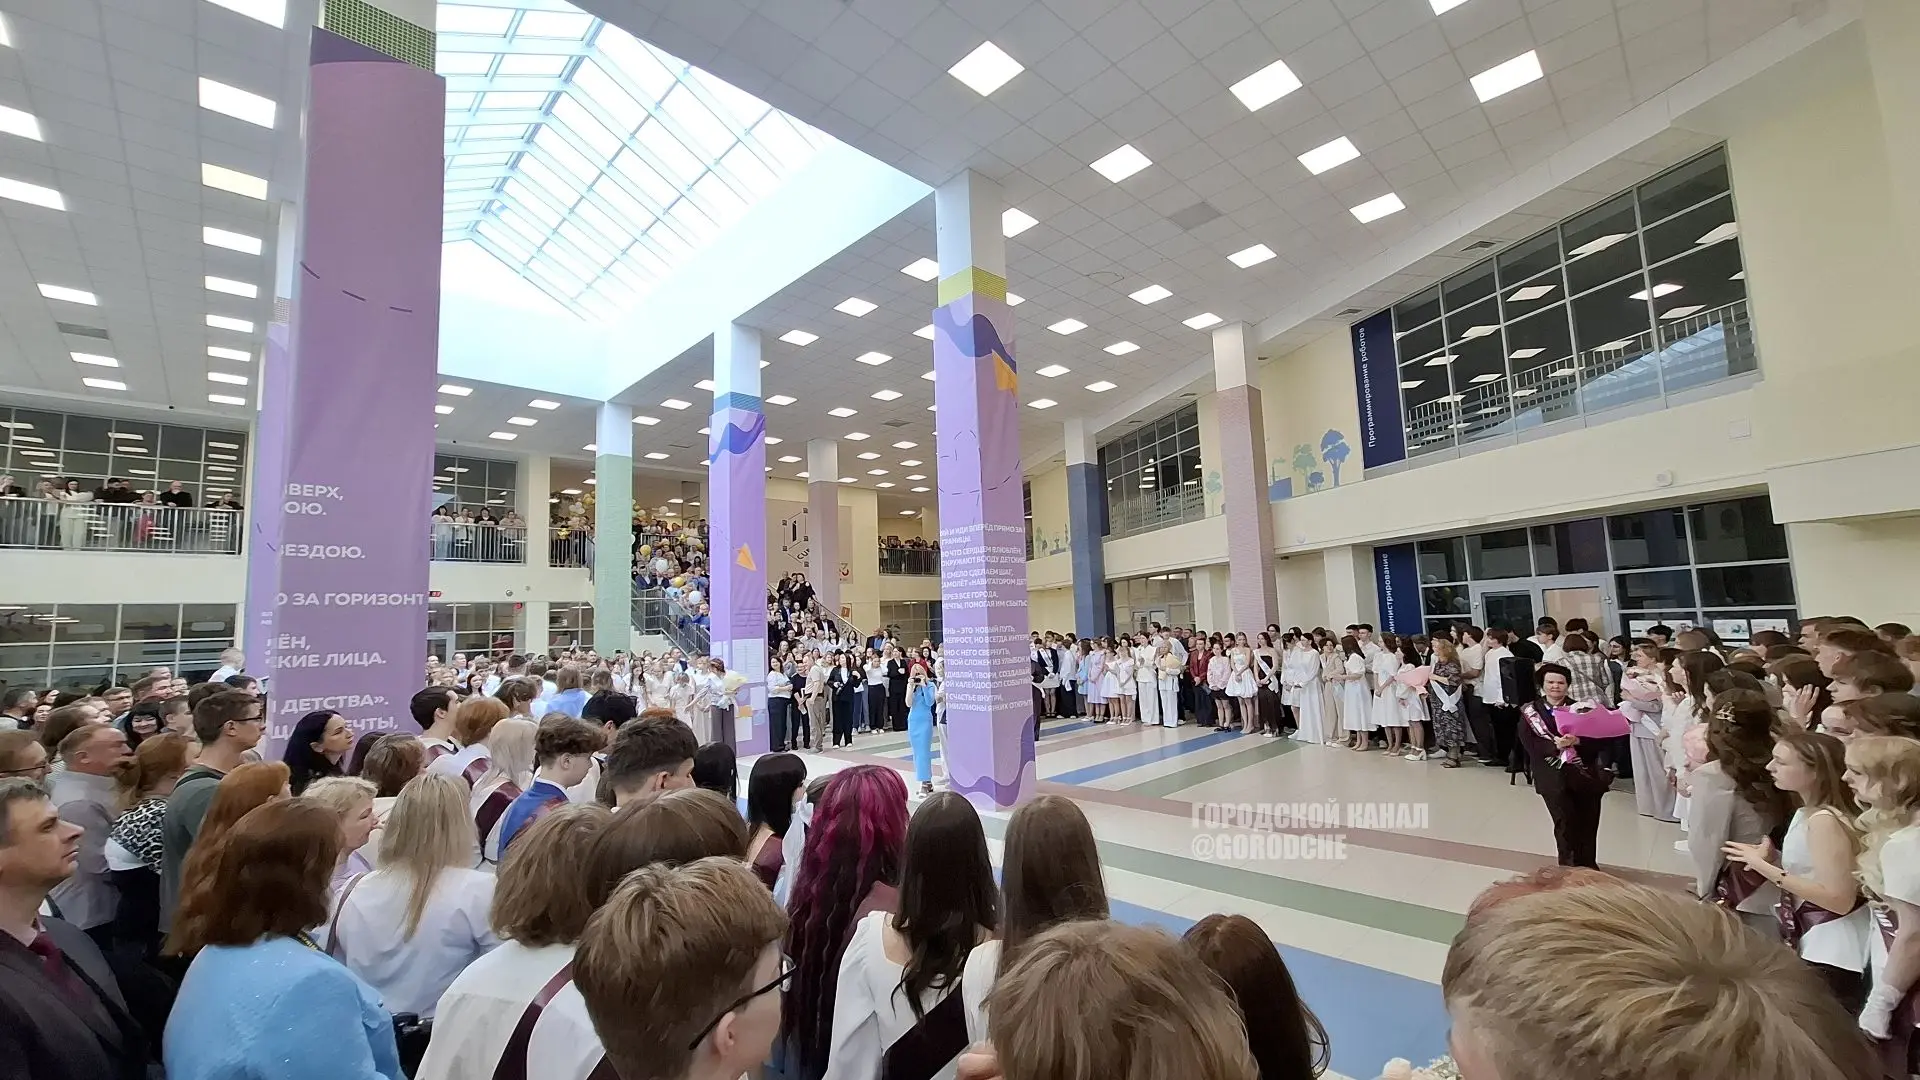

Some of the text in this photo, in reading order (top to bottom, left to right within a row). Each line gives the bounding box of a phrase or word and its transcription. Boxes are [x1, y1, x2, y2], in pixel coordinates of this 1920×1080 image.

[1358, 327, 1376, 448] Программирование роботов
[292, 593, 319, 606] ЗА
[324, 592, 424, 606] ГОРИЗОНТ
[1382, 553, 1396, 635] министрирование
[324, 652, 387, 667] ЛИЦА.
[344, 716, 399, 732] ЕЧТЫ,
